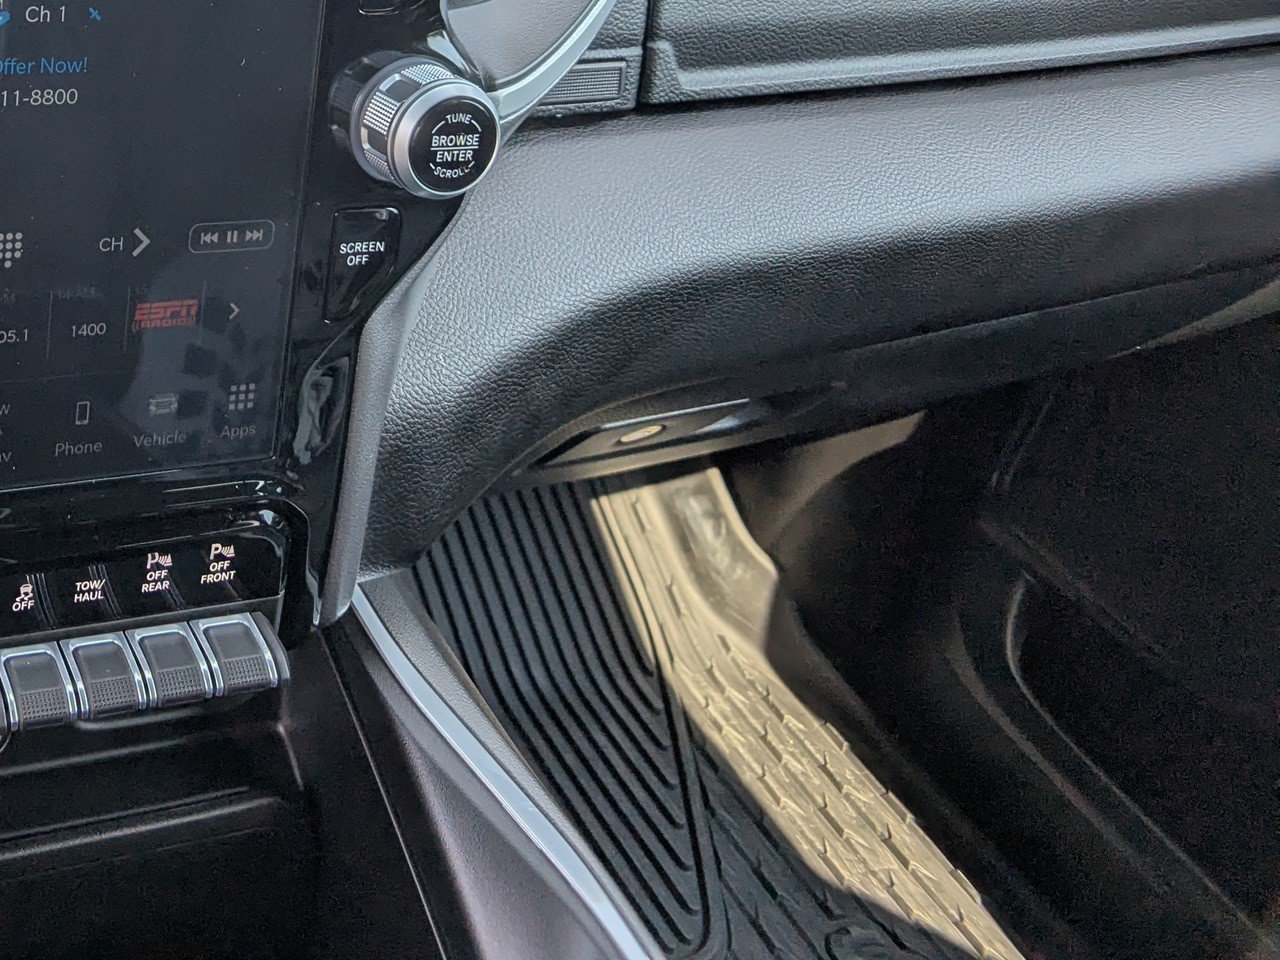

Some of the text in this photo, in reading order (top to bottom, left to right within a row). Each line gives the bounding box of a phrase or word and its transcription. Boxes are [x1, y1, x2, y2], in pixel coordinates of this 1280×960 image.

[25, 5, 66, 23] Ch 1
[40, 56, 88, 74] Now!
[446, 113, 473, 124] TUNE
[432, 134, 480, 147] BROWSE
[436, 150, 474, 163] ENTER
[433, 165, 470, 179] SCROLL
[98, 236, 124, 252] CH
[339, 241, 385, 254] SCREEN
[347, 255, 370, 266] OFF
[71, 323, 107, 338] 1400
[220, 423, 256, 439] Apps
[132, 431, 187, 448] Vehicle
[54, 441, 103, 457] Phone
[209, 560, 231, 572] OFF
[146, 569, 169, 581] OFF
[200, 570, 236, 585] FRONT
[75, 578, 106, 591] TOW/
[141, 580, 170, 593] REAR
[74, 591, 105, 603] HAUL
[12, 599, 35, 612] OFF
